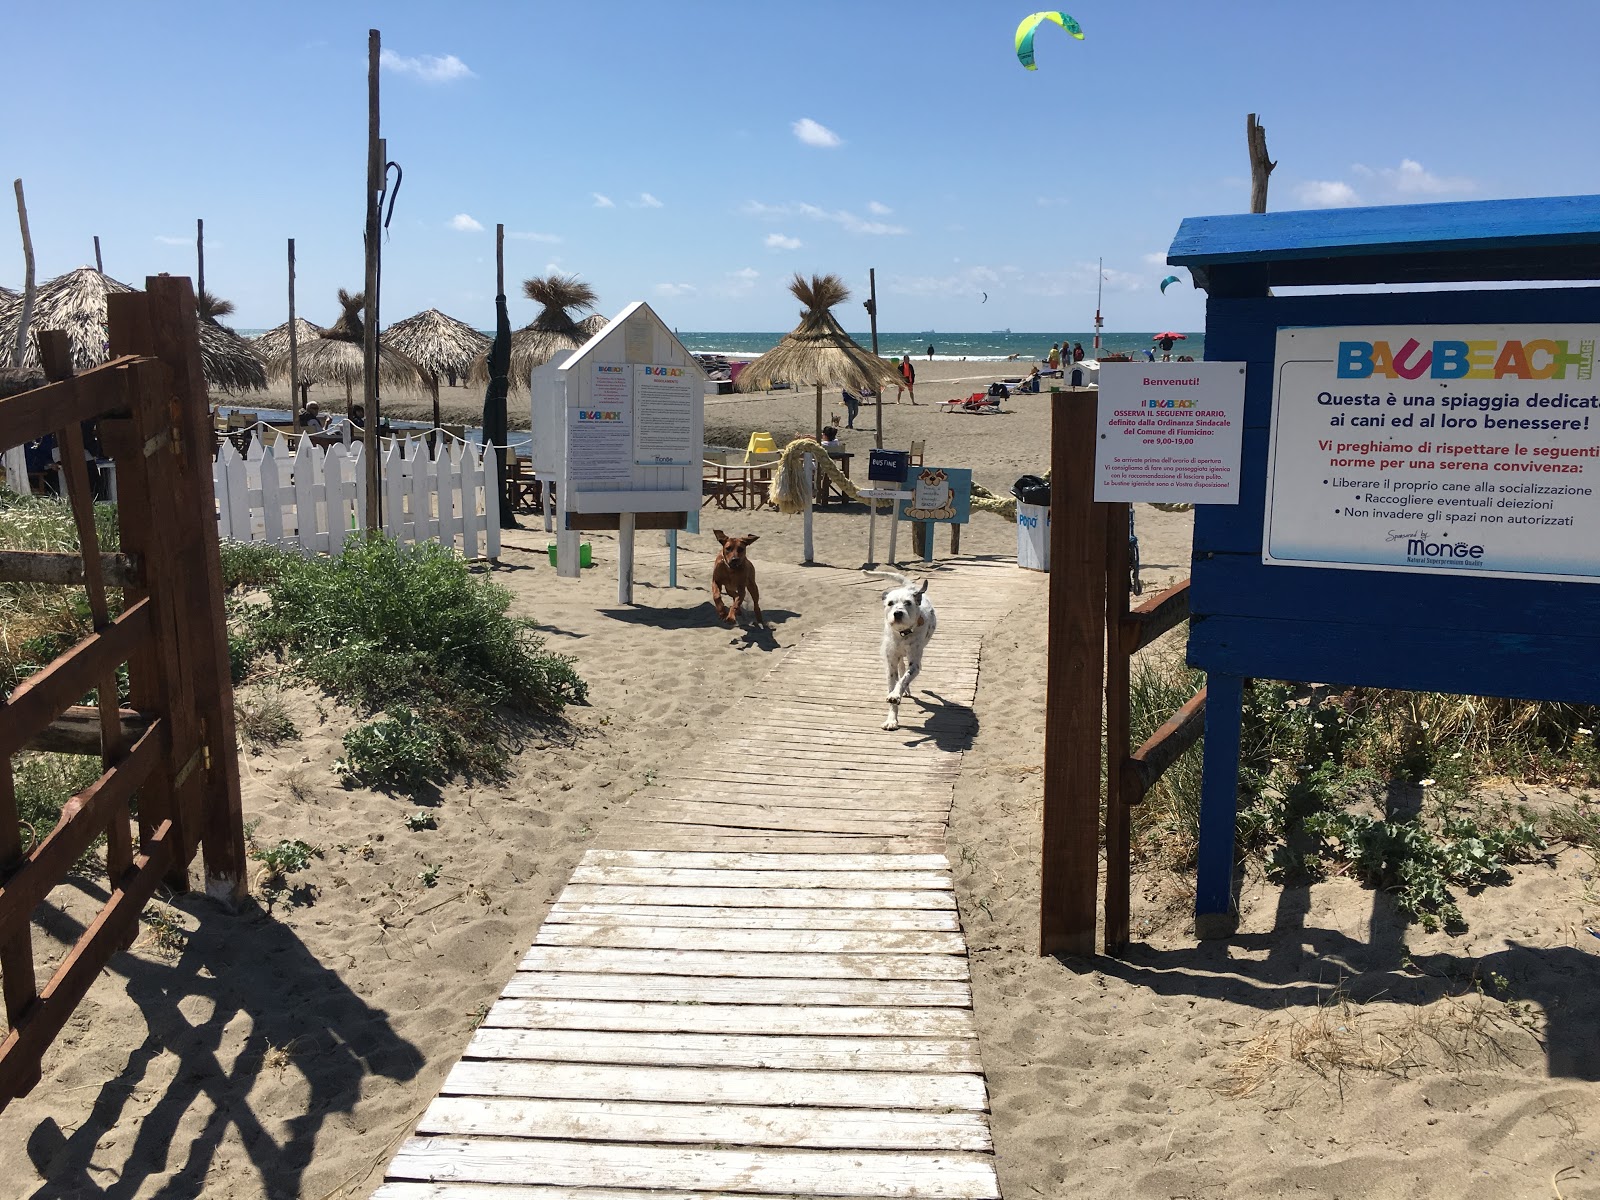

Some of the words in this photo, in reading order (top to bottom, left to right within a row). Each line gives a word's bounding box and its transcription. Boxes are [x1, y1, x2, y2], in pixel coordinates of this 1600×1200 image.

[1337, 338, 1594, 380] BAUBEACH
[1578, 340, 1594, 380] VILLAGE
[1149, 400, 1197, 408] BAUBEACH
[1318, 392, 1380, 406] Questa
[1386, 393, 1396, 406] è
[1404, 396, 1435, 406] una
[1442, 393, 1519, 411] spiaggia
[1330, 413, 1344, 426] ai
[1351, 413, 1385, 427] cani
[1391, 413, 1414, 427] ed
[1420, 414, 1435, 428] al
[1441, 414, 1477, 428] loro
[1484, 414, 1589, 430] benessere!
[1319, 440, 1332, 451] Vi
[1337, 441, 1413, 454] preghiamo
[1418, 442, 1431, 453] di
[1436, 442, 1509, 456] rispettare
[1515, 444, 1528, 455] le
[1533, 446, 1600, 459] seguenti
[872, 459, 897, 468] BUSTINE
[1330, 459, 1375, 468] norme
[1380, 460, 1404, 470] per
[1410, 460, 1434, 469] una
[1440, 461, 1488, 470] serena
[1494, 461, 1583, 473] convivenza:
[1332, 478, 1380, 488] Liberare
[1384, 479, 1390, 488] il
[1394, 481, 1438, 492] proprio
[1474, 482, 1495, 492] alla
[1499, 483, 1592, 496] socializzazione
[1365, 493, 1433, 506] Raccogliere
[1438, 497, 1493, 507] eventuali
[1497, 498, 1553, 509] deiezioni
[1344, 507, 1368, 518] Non
[1373, 509, 1423, 520] invadere
[1427, 510, 1442, 522] gli
[1446, 513, 1476, 524] spazi
[1480, 514, 1503, 523] non
[1508, 516, 1573, 526] autorizzati
